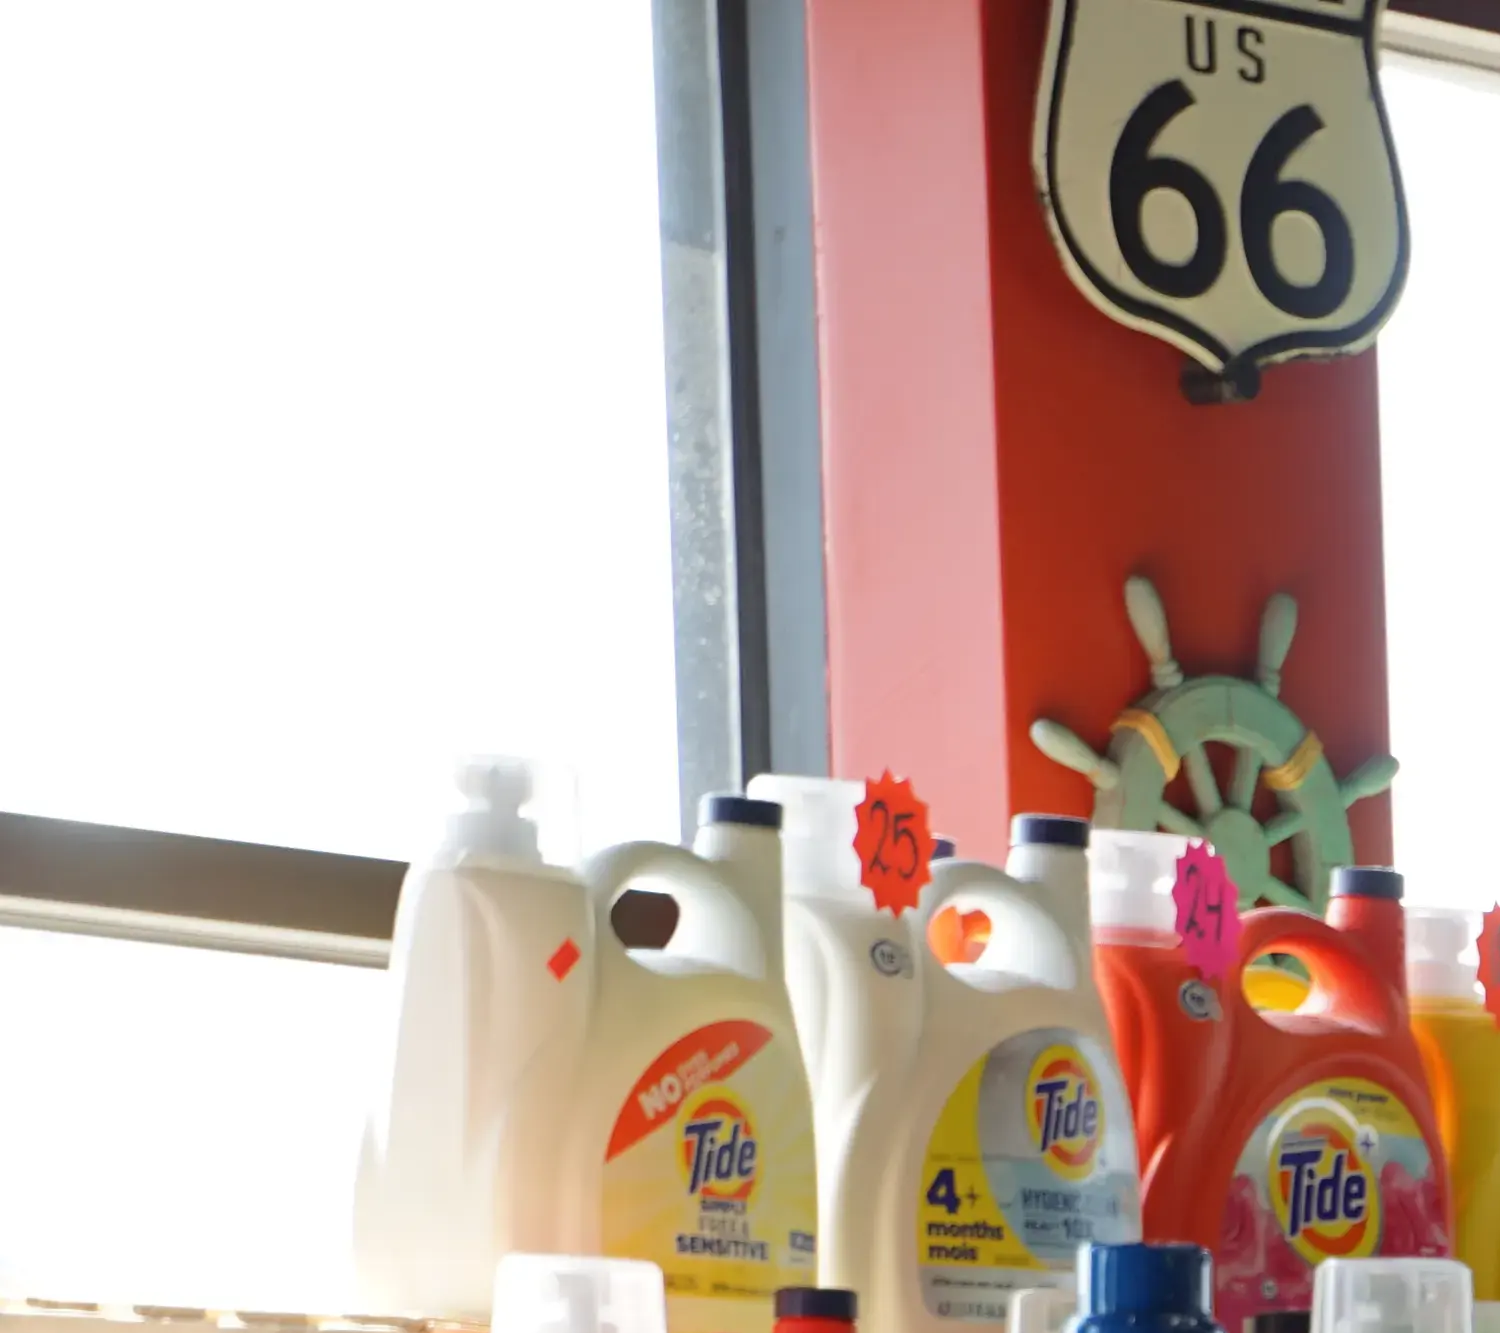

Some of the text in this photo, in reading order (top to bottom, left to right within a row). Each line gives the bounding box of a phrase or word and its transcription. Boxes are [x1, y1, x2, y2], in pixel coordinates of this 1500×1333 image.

[1185, 15, 1265, 84] US
[1109, 79, 1355, 319] 66
[869, 800, 920, 881] 25
[639, 1074, 682, 1120] NO
[1036, 1078, 1098, 1153] Tide
[685, 1120, 757, 1195] Tide
[1280, 1148, 1367, 1238] Tide
[677, 1234, 769, 1261] SENSITIVE
[926, 1220, 1004, 1243] months
[927, 1242, 979, 1262] mois
